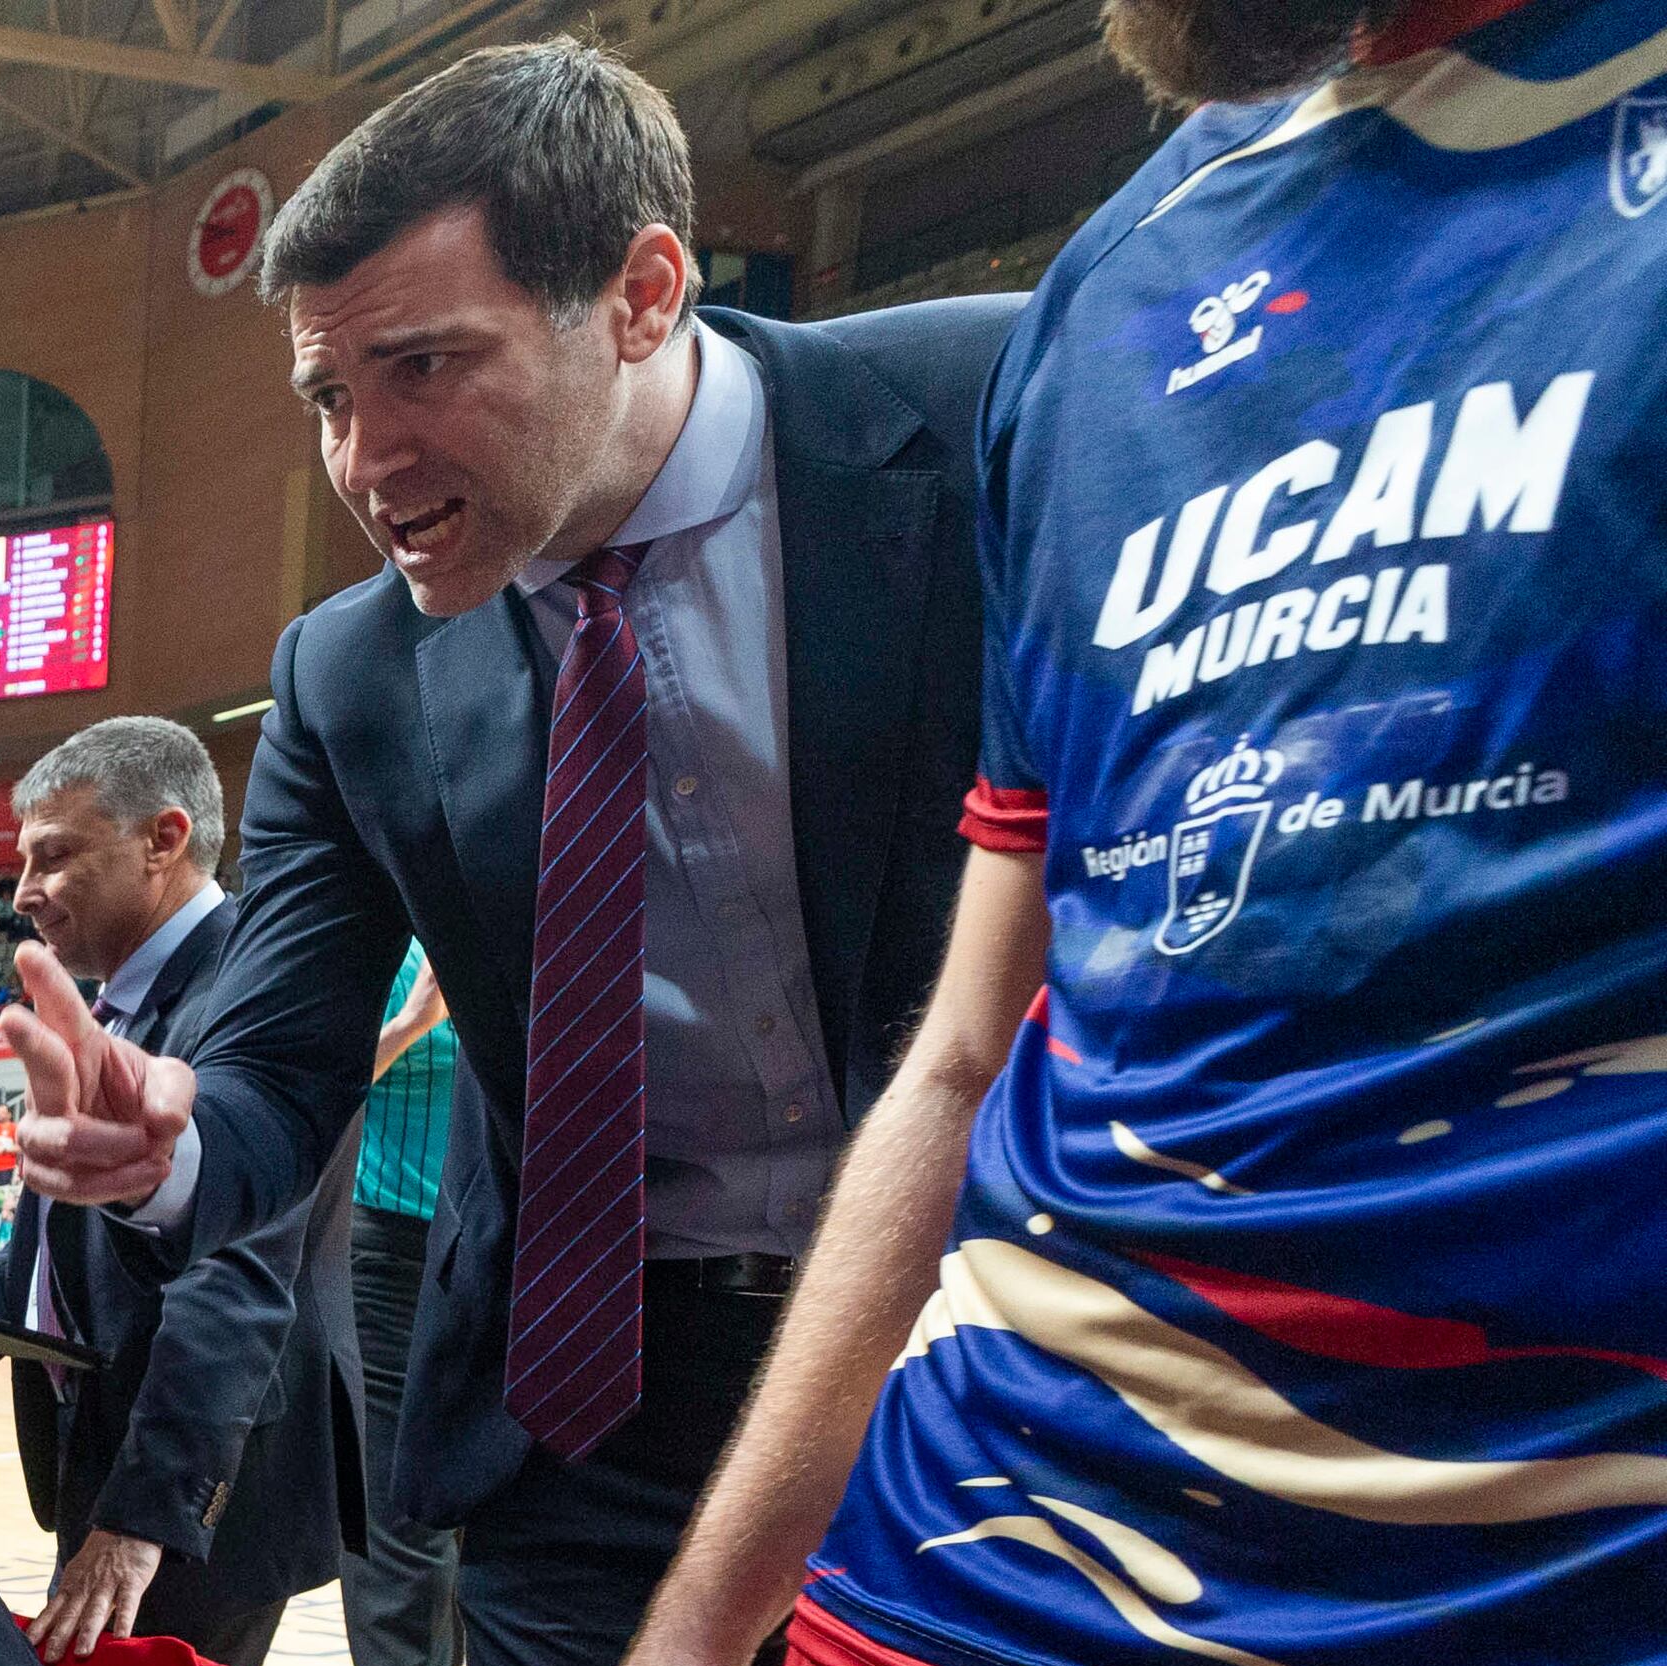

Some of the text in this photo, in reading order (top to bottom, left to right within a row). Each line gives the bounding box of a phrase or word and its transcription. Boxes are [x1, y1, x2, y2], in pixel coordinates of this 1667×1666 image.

[1092, 369, 1597, 651] UCAM
[1132, 563, 1450, 718] MURCIA
[1081, 762, 1571, 881] Región de Murcia
